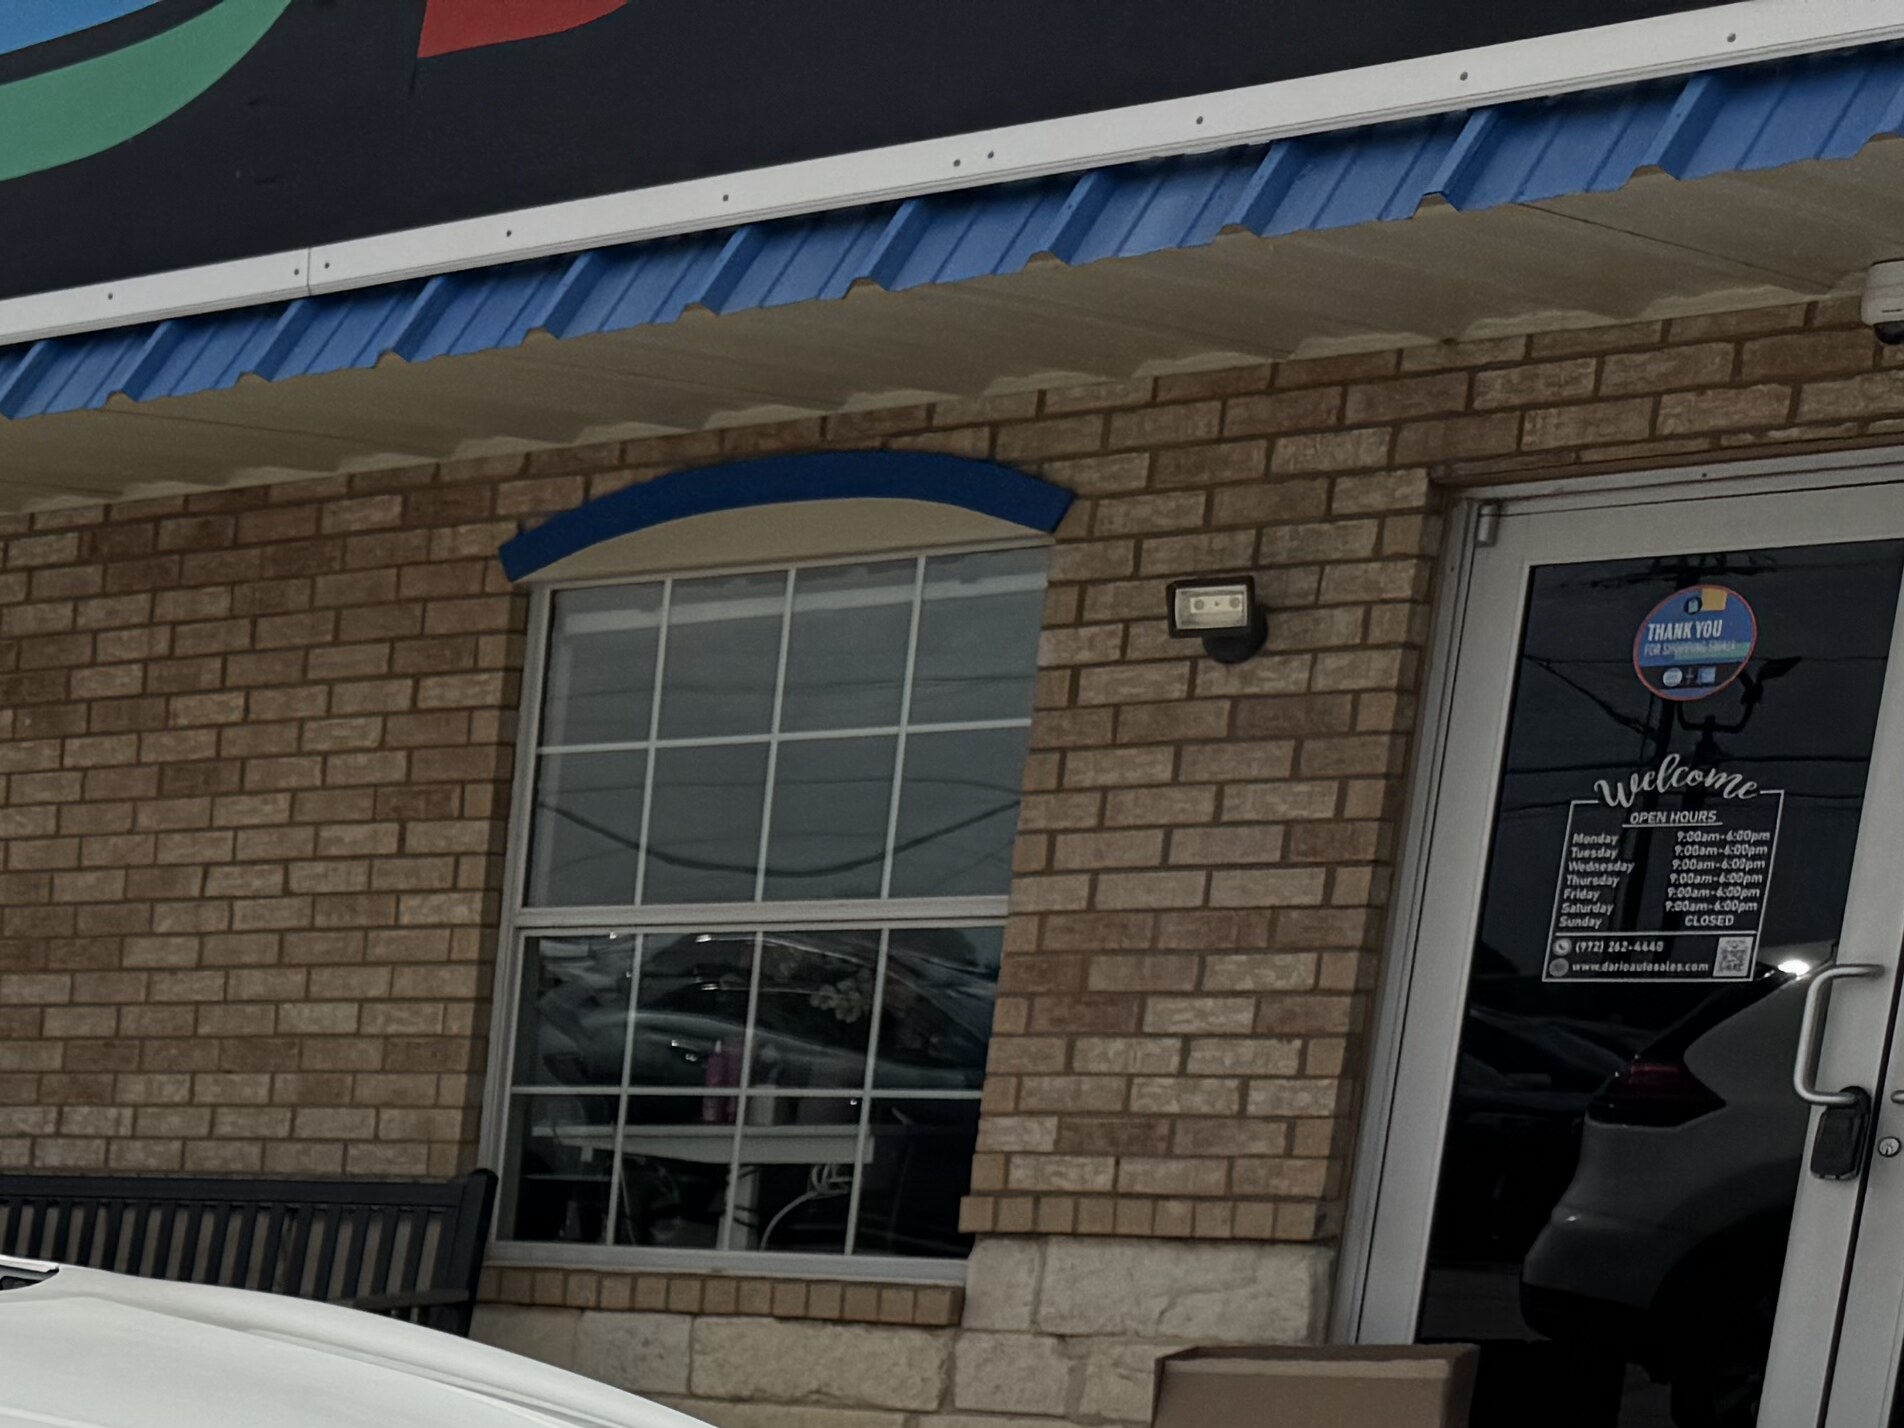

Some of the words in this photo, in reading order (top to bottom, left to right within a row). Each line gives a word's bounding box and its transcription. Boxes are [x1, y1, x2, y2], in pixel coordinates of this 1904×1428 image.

[1648, 622, 1693, 641] THANK
[1696, 619, 1723, 638] YOU
[1644, 643, 1661, 657] FOR
[1594, 753, 1758, 808] Welcome
[1630, 811, 1666, 824] OPEN
[1670, 810, 1717, 823] HOURS
[1572, 832, 1619, 846] Monday
[1571, 846, 1619, 860] Tuesday
[1568, 861, 1635, 874] Wednesday
[1566, 874, 1620, 888] Thursday
[1563, 888, 1601, 902] Friday
[1561, 902, 1614, 916] Saturday
[1558, 916, 1603, 929] Sunday
[1684, 915, 1734, 927] CLOSED
